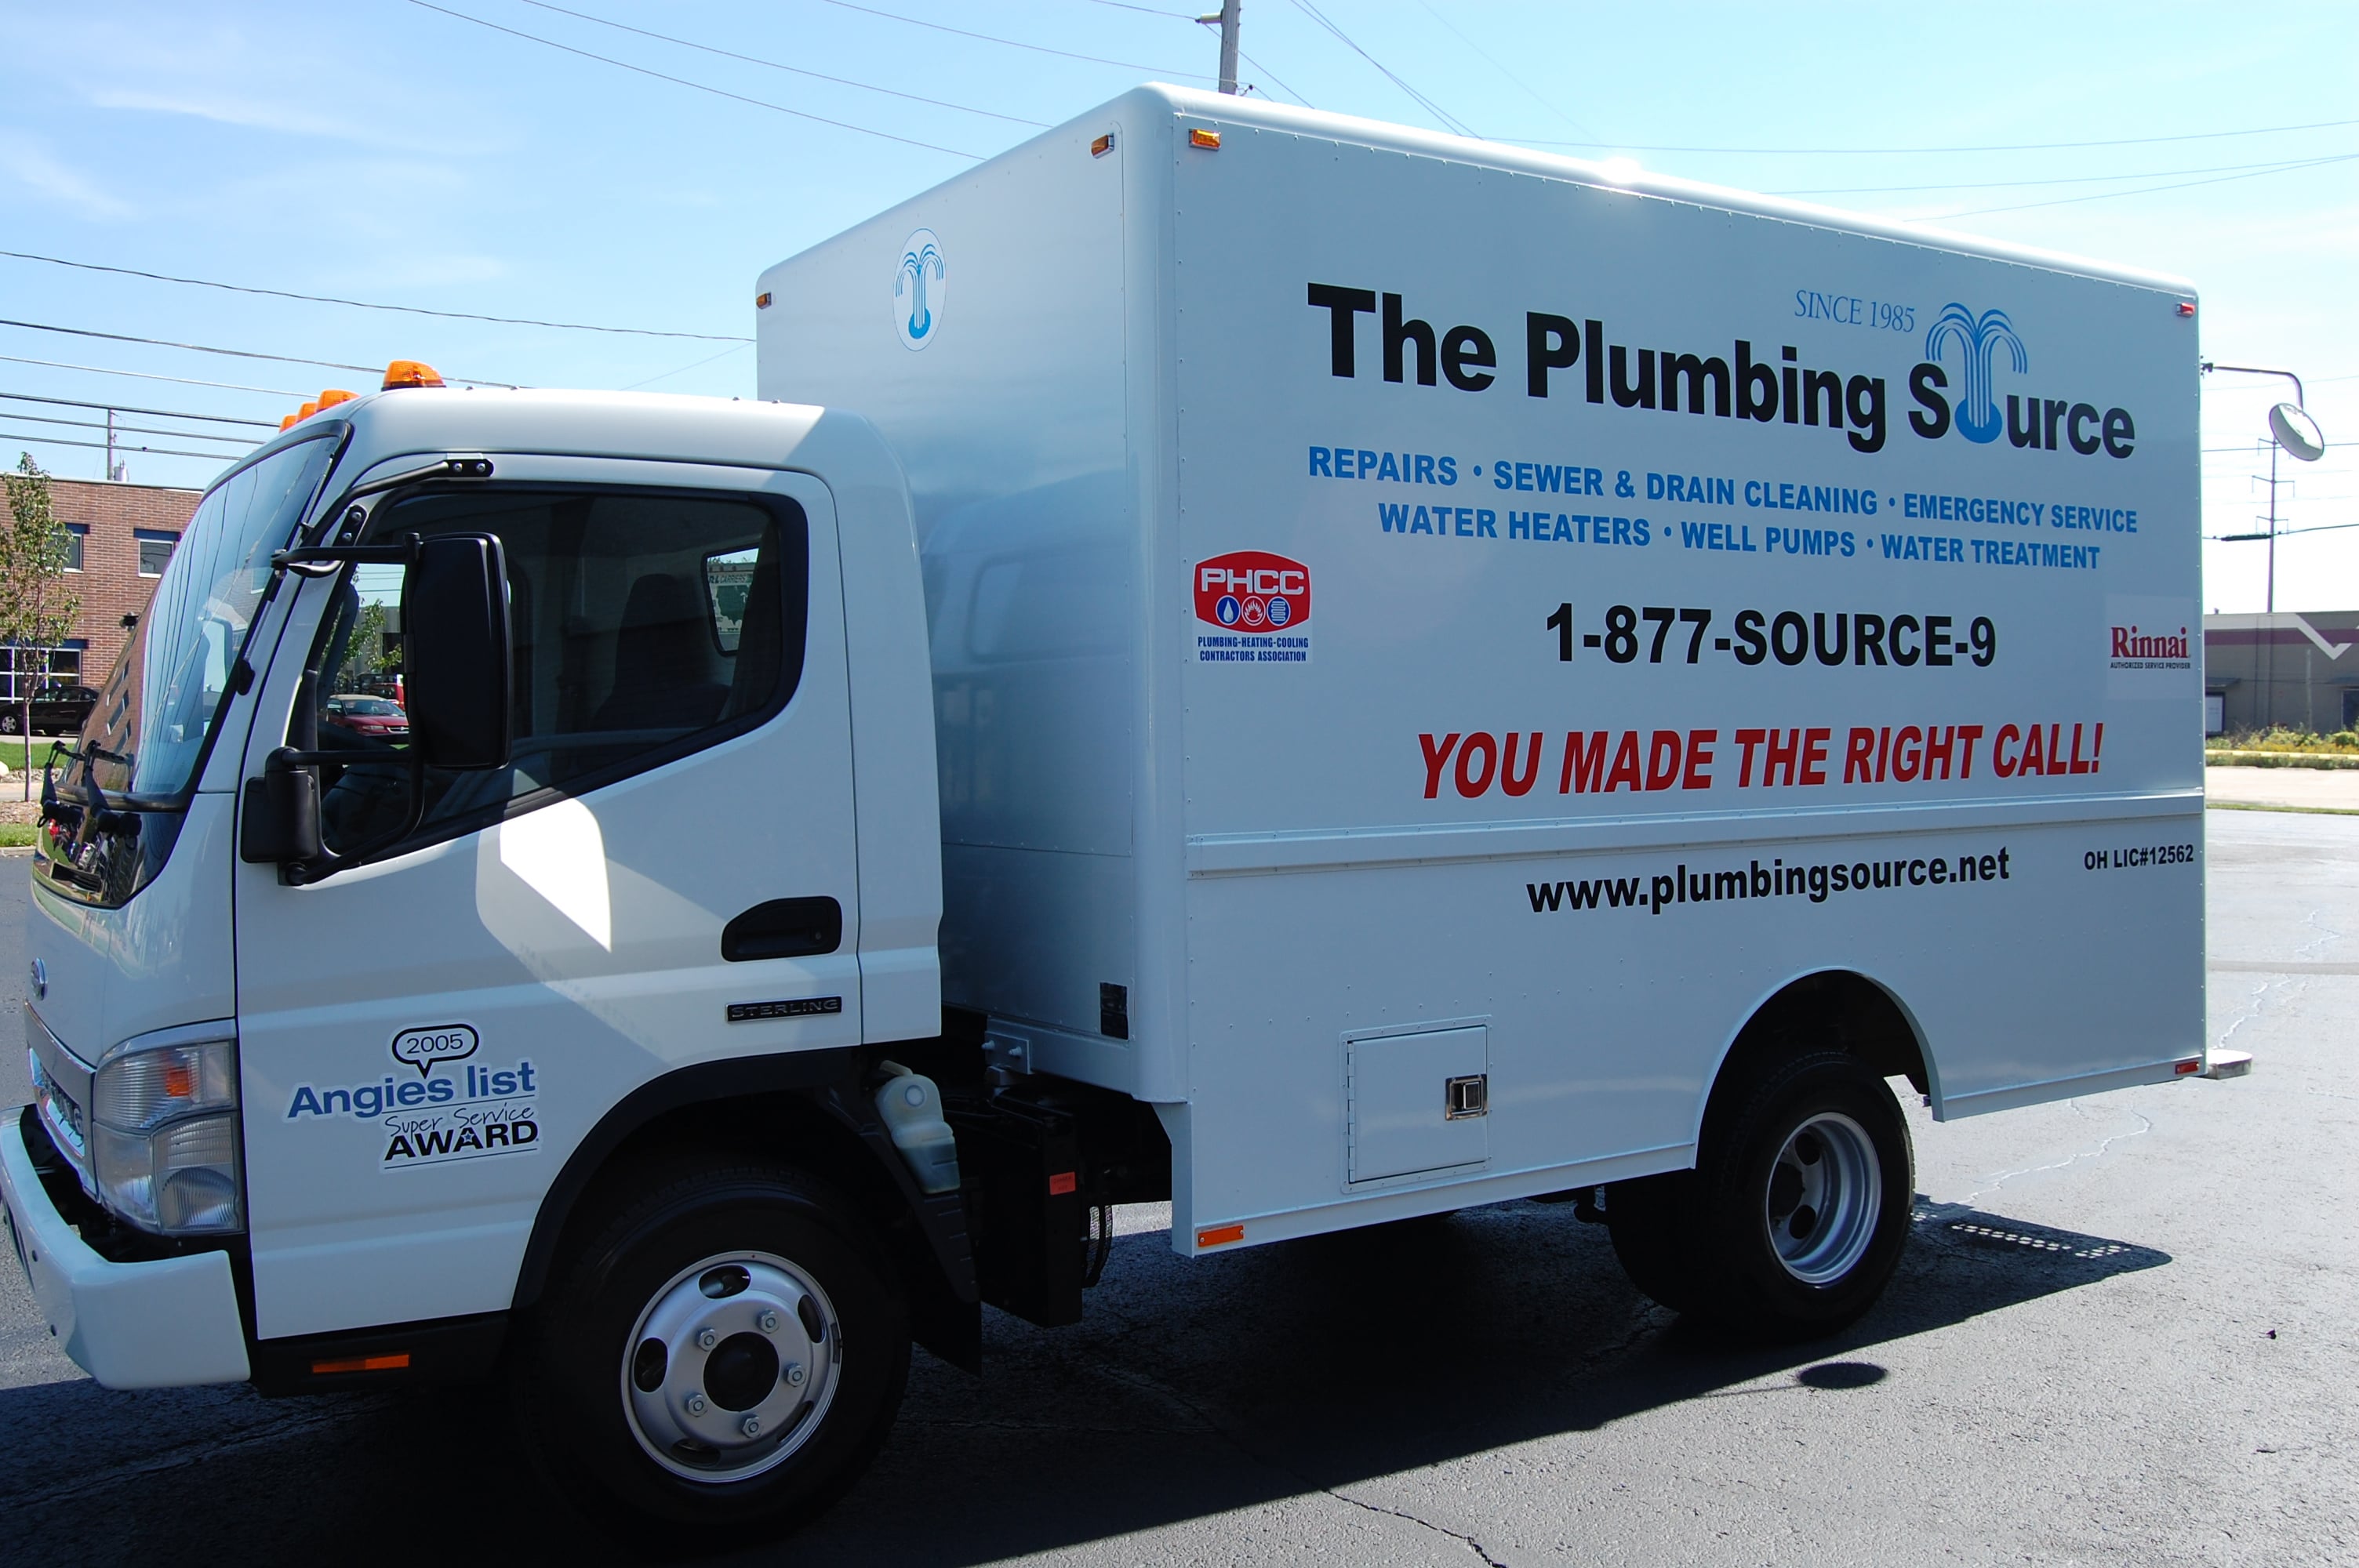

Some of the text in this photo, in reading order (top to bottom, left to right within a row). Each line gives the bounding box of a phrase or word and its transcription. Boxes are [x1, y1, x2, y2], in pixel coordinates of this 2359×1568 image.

[1795, 290, 1914, 332] SINCE 1985
[1308, 282, 1496, 391] The
[1526, 311, 1888, 453] Plumbing
[1310, 446, 2137, 532] REPAIRS SEWER & DRAIN CLEANING EMERGENCY SERVICE
[1379, 503, 2099, 568] WATER HEATERS WELL PUMPS WATER TREATMENT
[1201, 568, 1305, 596] PHCC
[1198, 637, 1308, 648] PLUMBING-HEATING-COOLING
[1547, 603, 1995, 666] 1-877-SOURCE-9
[2110, 625, 2190, 659] Rinnai
[1200, 651, 1306, 661] CONTRACTORS ASSOCIATION
[1419, 723, 2103, 798] YOU MADE THE RIGHT CALL!
[2085, 844, 2194, 869] OH LIC#12562
[1527, 847, 2009, 914] www.plumbingsource.net
[732, 999, 838, 1018] STERLING
[405, 1033, 464, 1054] 2005
[285, 1061, 536, 1119] Angies list
[383, 1102, 535, 1143] Super Service
[383, 1120, 539, 1161] AWARD
